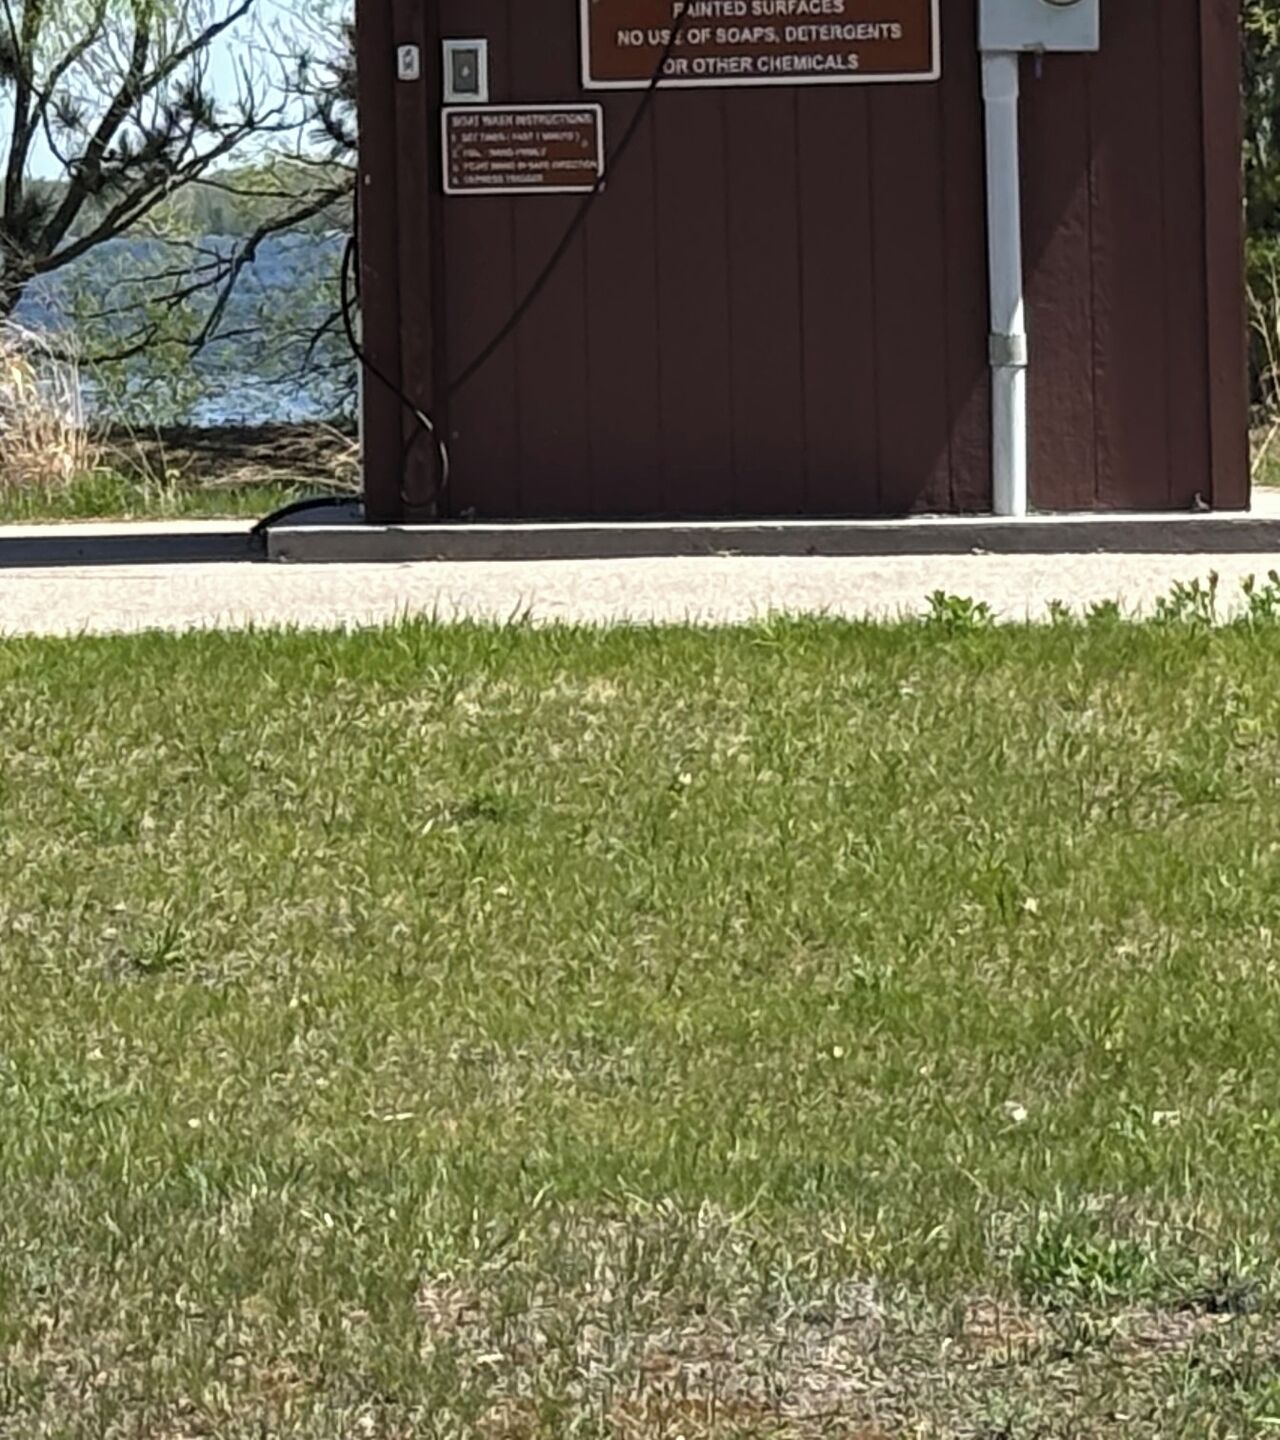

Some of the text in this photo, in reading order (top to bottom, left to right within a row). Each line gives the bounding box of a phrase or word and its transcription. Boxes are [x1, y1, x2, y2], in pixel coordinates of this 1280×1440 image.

[618, 30, 643, 45] NO
[688, 29, 710, 43] OF
[716, 27, 779, 43] SOAPS,
[785, 23, 901, 42] DETERGENTS
[664, 54, 858, 74] OR OTHER CHEMICALS
